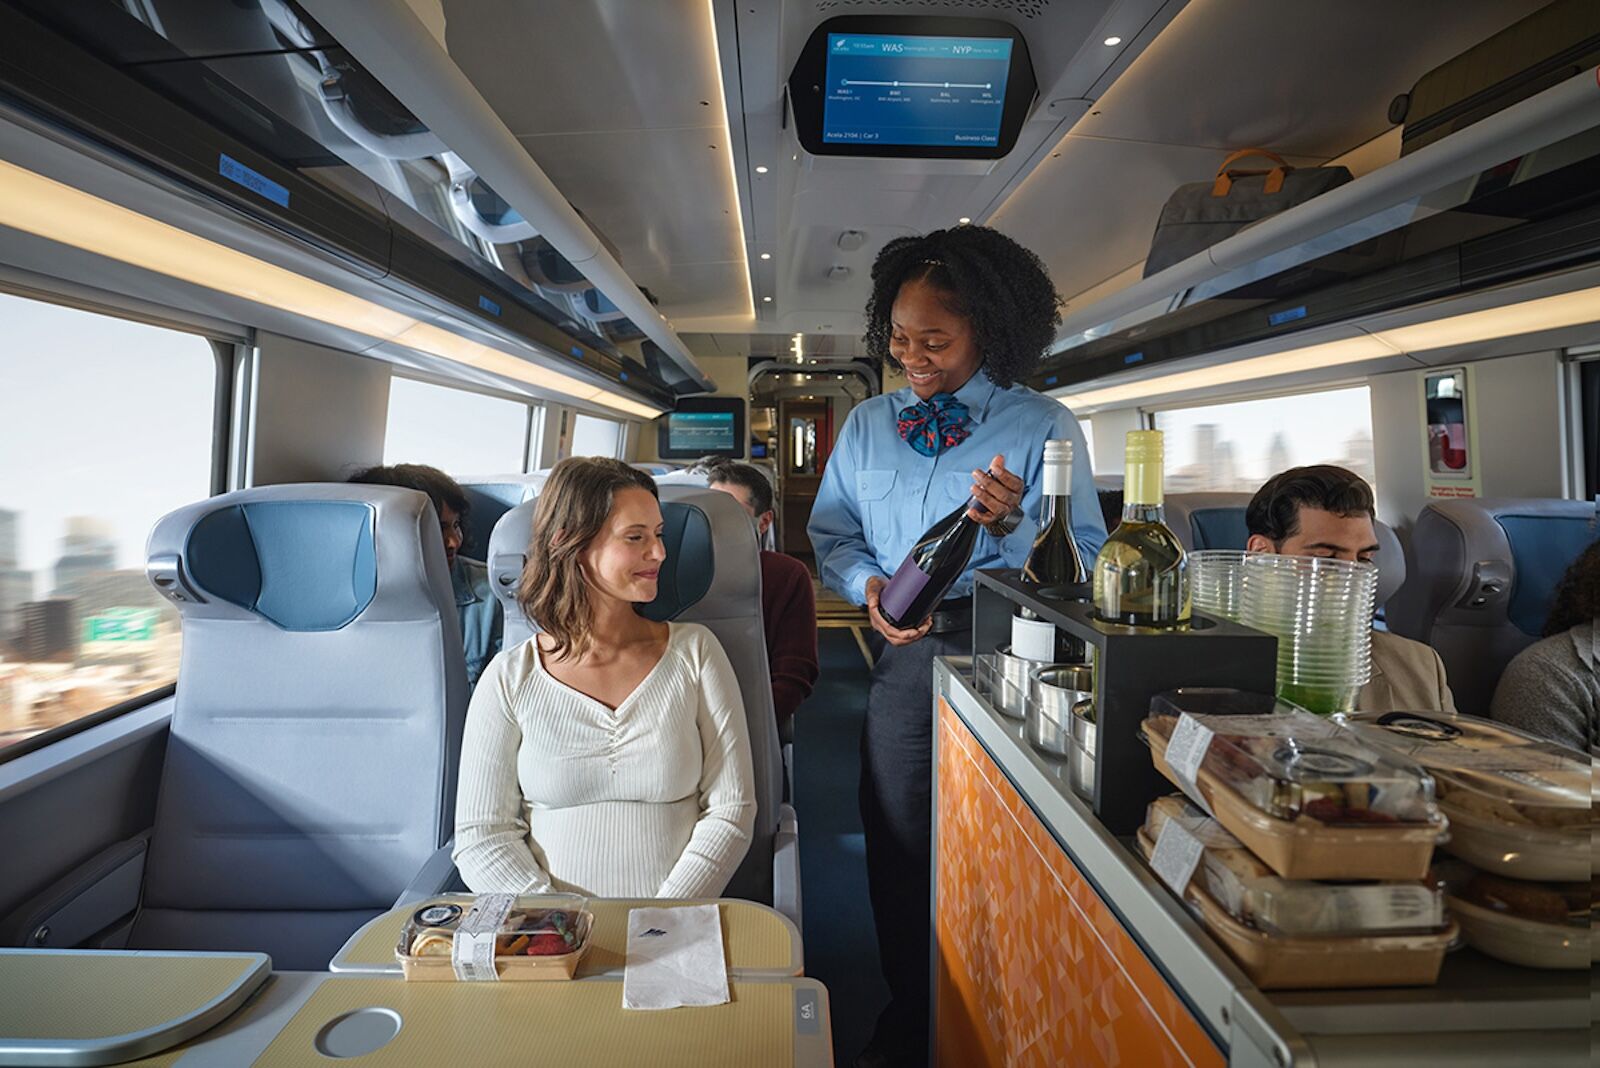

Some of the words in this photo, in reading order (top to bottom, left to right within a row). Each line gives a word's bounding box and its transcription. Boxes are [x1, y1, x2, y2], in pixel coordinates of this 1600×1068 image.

[881, 43, 904, 53] WAS
[952, 45, 972, 54] NYP
[801, 1002, 811, 1020] 6A
